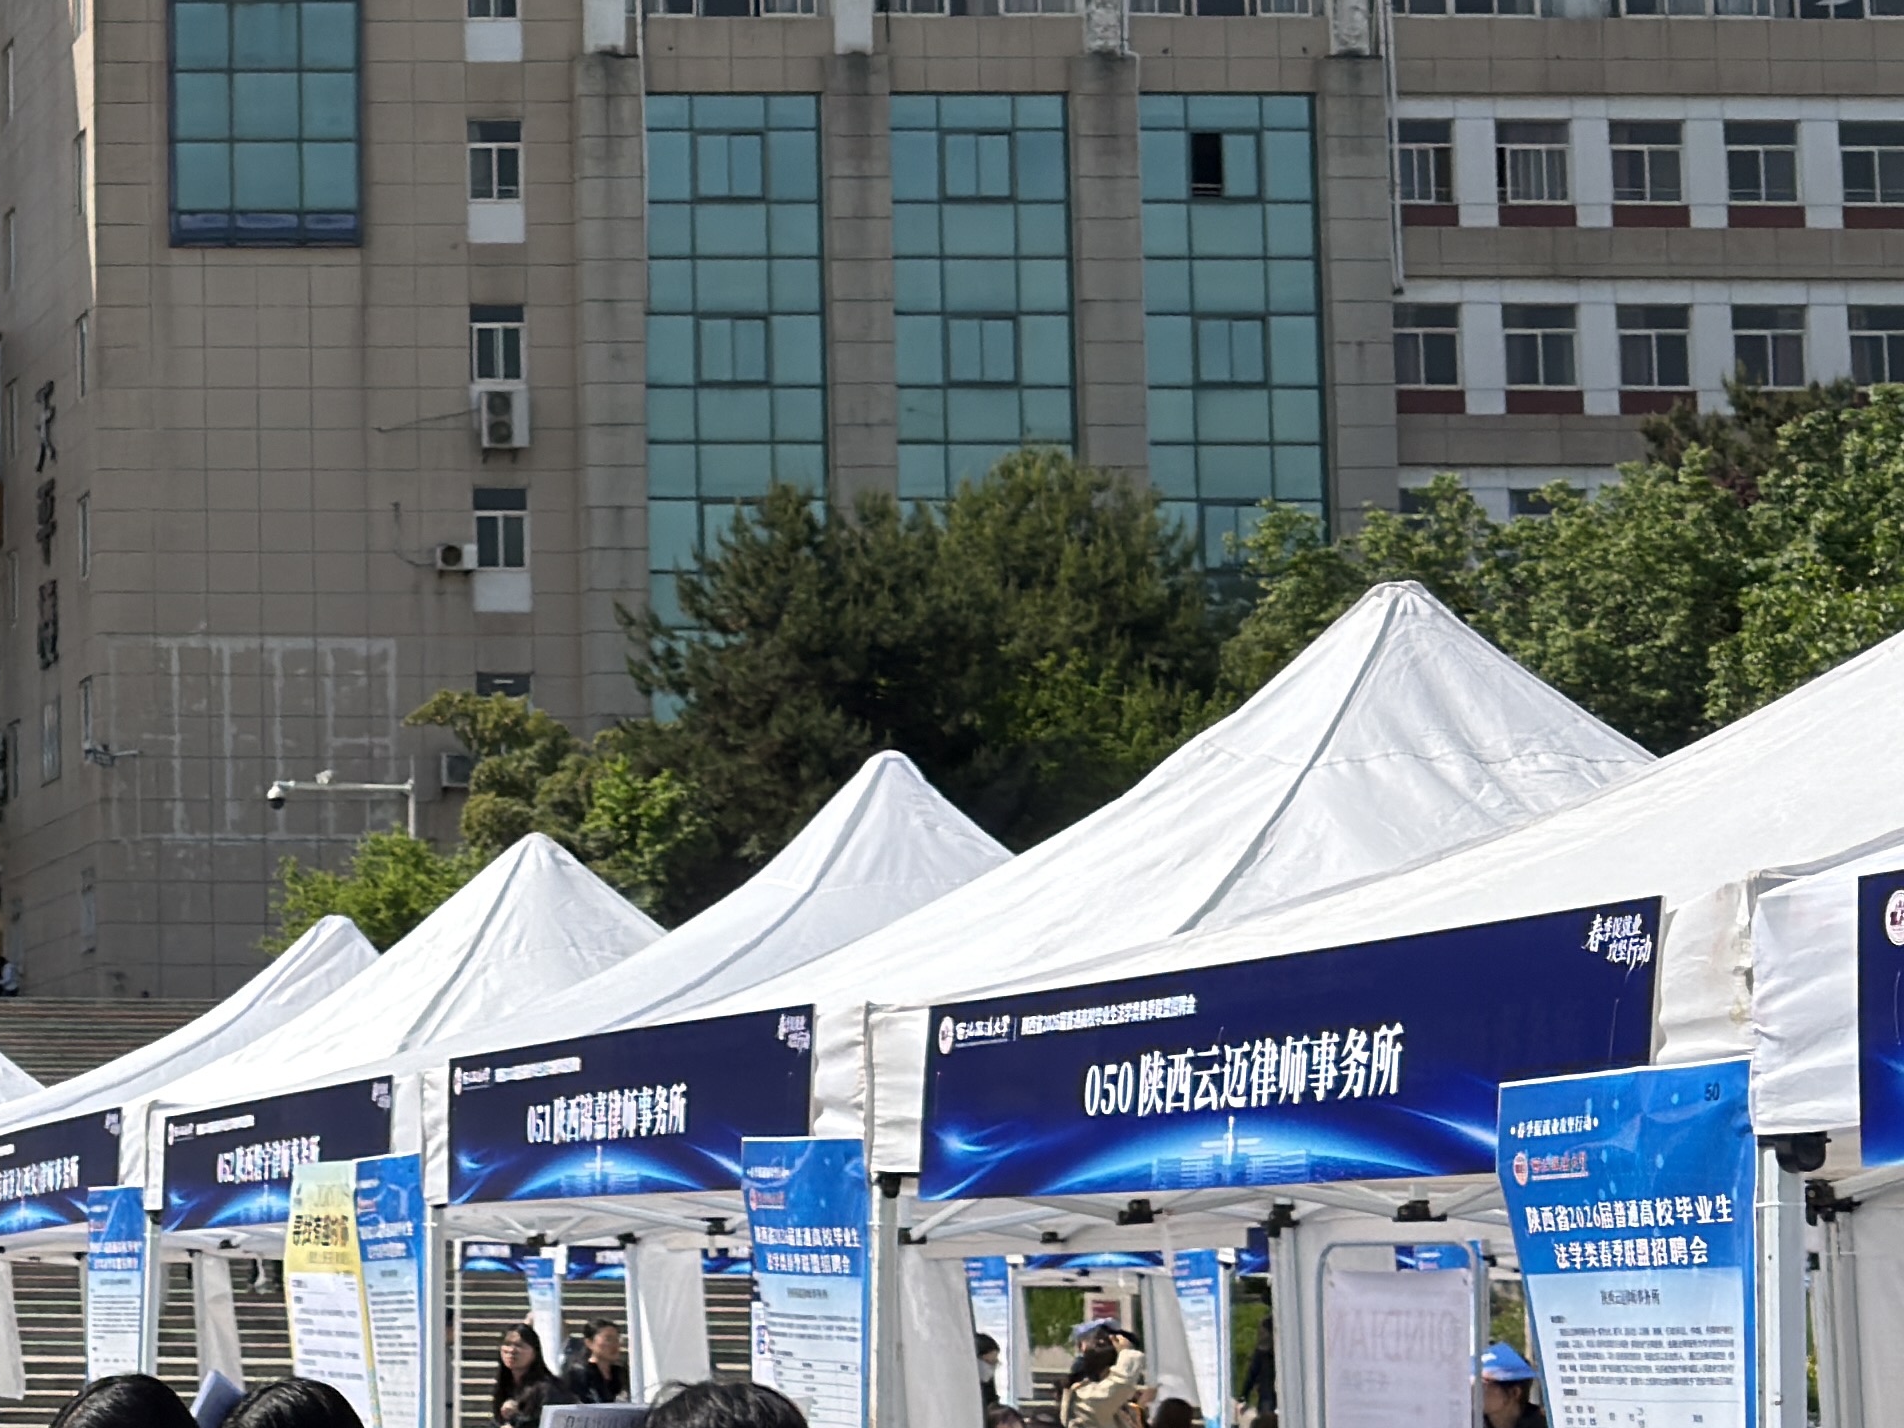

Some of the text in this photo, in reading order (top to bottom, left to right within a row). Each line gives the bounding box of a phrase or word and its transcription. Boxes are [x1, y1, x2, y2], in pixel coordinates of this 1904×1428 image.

[1084, 1021, 1407, 1119] 050 陕西云迈律师事务所
[1703, 1082, 1721, 1103] 50
[526, 1104, 551, 1144] 051
[1525, 1193, 1733, 1235] 陕西省2026届普通高校毕业生
[1554, 1234, 1709, 1271] 法学类春季联盟招聘会
